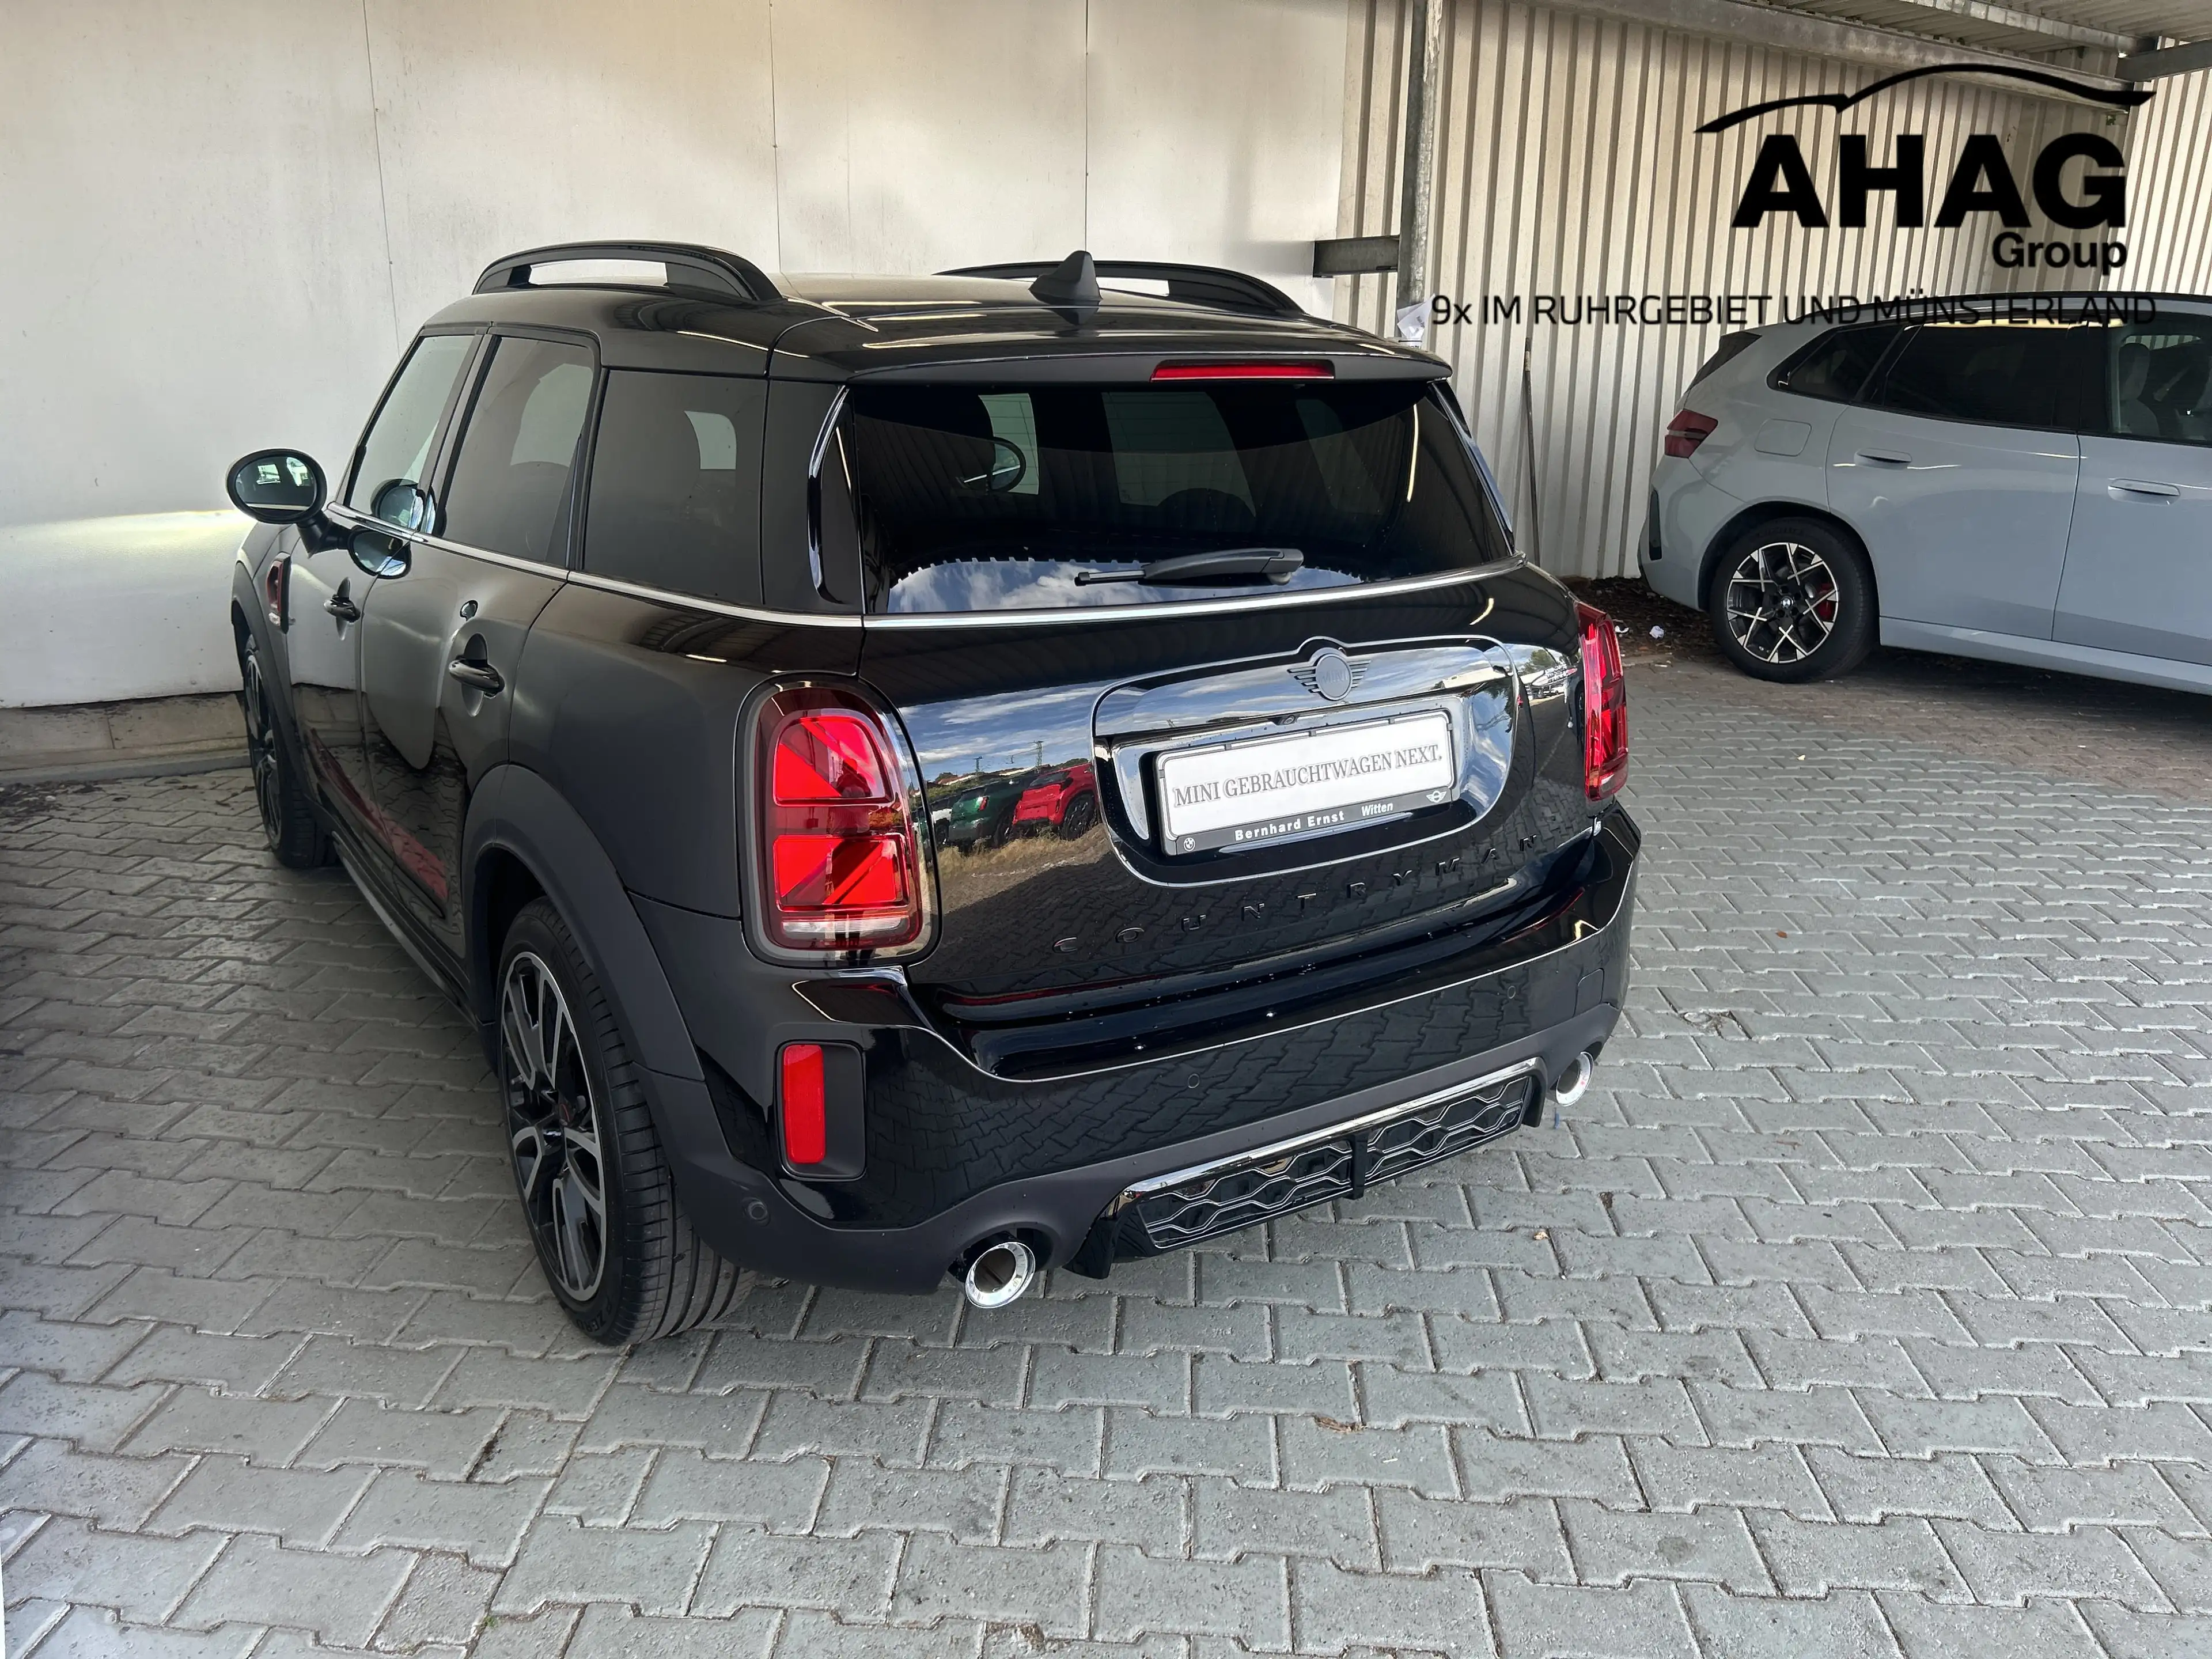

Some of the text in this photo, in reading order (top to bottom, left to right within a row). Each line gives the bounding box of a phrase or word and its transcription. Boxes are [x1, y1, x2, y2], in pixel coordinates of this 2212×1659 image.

[1176, 744, 1442, 806] MINI GEBRAUCHTWAGEN NEXT.
[1234, 802, 1393, 841] Bernhard Ernst Witten
[1051, 834, 1538, 954] COUNTRYMAN
